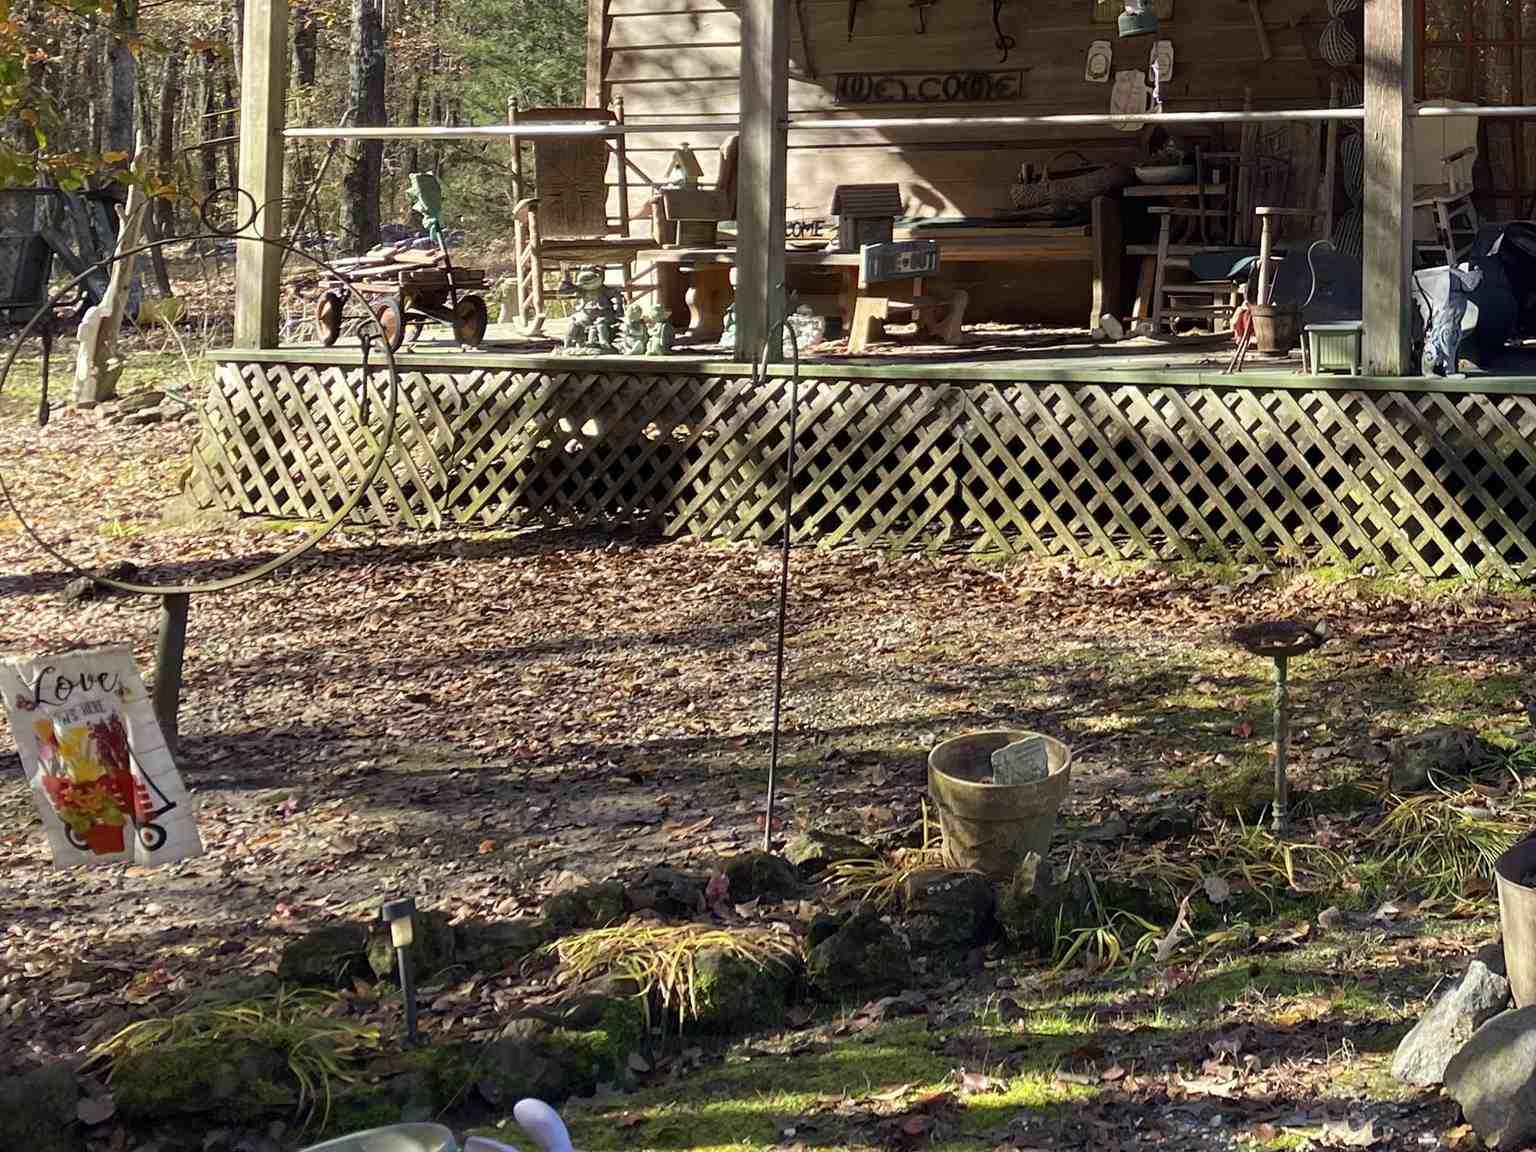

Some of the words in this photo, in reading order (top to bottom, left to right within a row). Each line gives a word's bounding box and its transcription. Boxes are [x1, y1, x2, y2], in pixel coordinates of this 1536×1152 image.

[843, 73, 1018, 101] WELCOME
[785, 221, 825, 237] COME
[34, 666, 118, 706] Love
